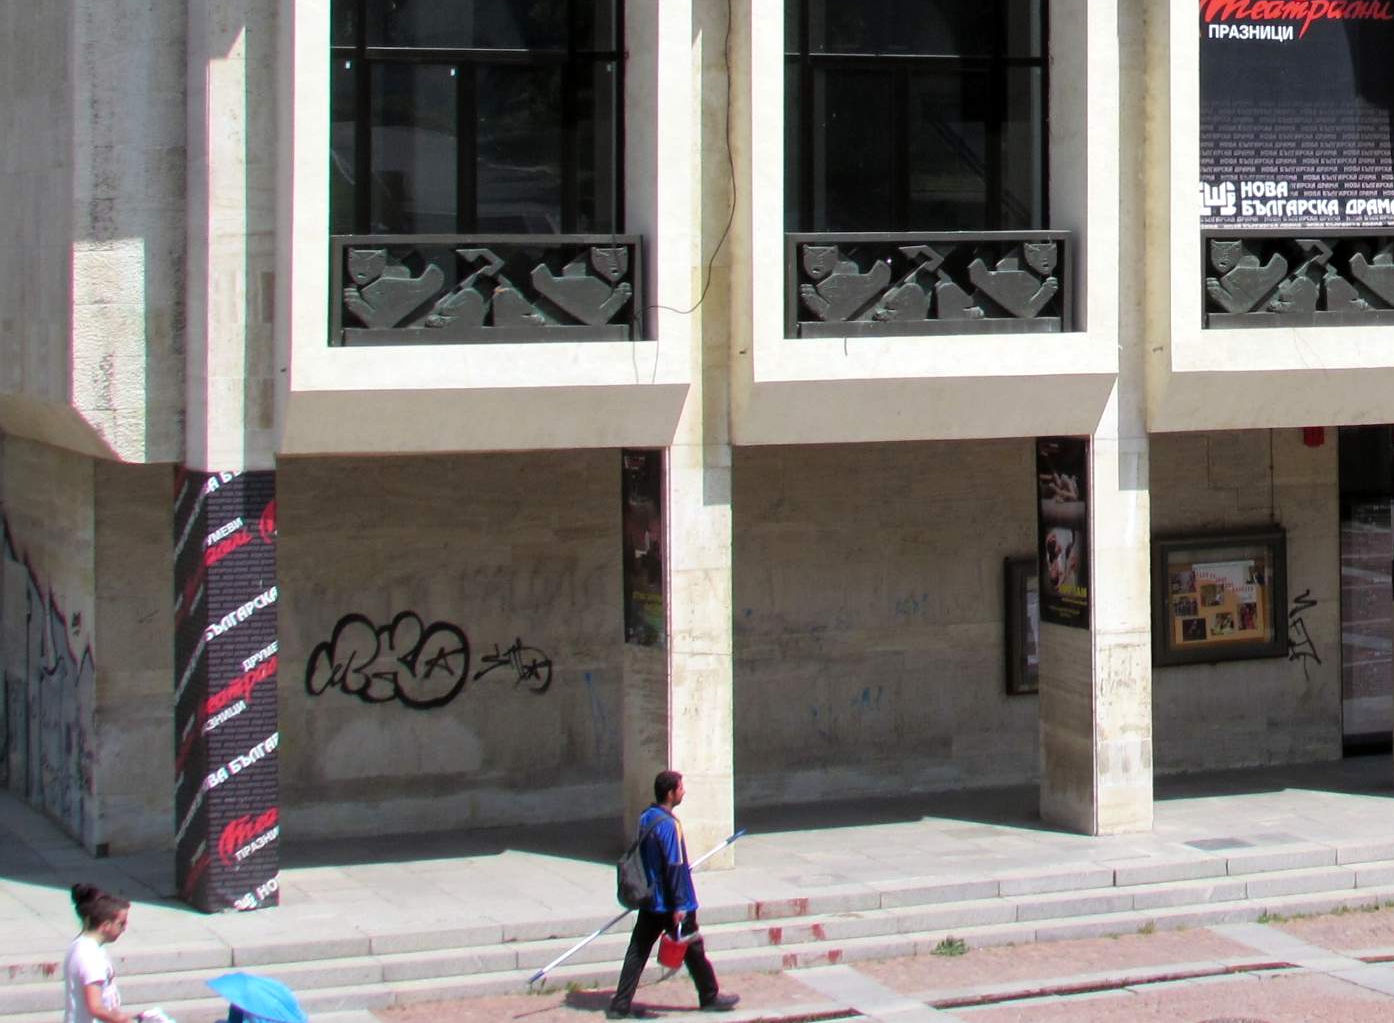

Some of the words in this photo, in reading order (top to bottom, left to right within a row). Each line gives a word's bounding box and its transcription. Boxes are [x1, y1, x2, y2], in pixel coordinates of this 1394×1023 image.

[1208, 23, 1294, 43] ПРАЗНИЦИ
[1240, 181, 1288, 199] НОВА
[1240, 199, 1340, 217] БЪЛГАРСКА
[240, 641, 280, 673] ДРУМЕ
